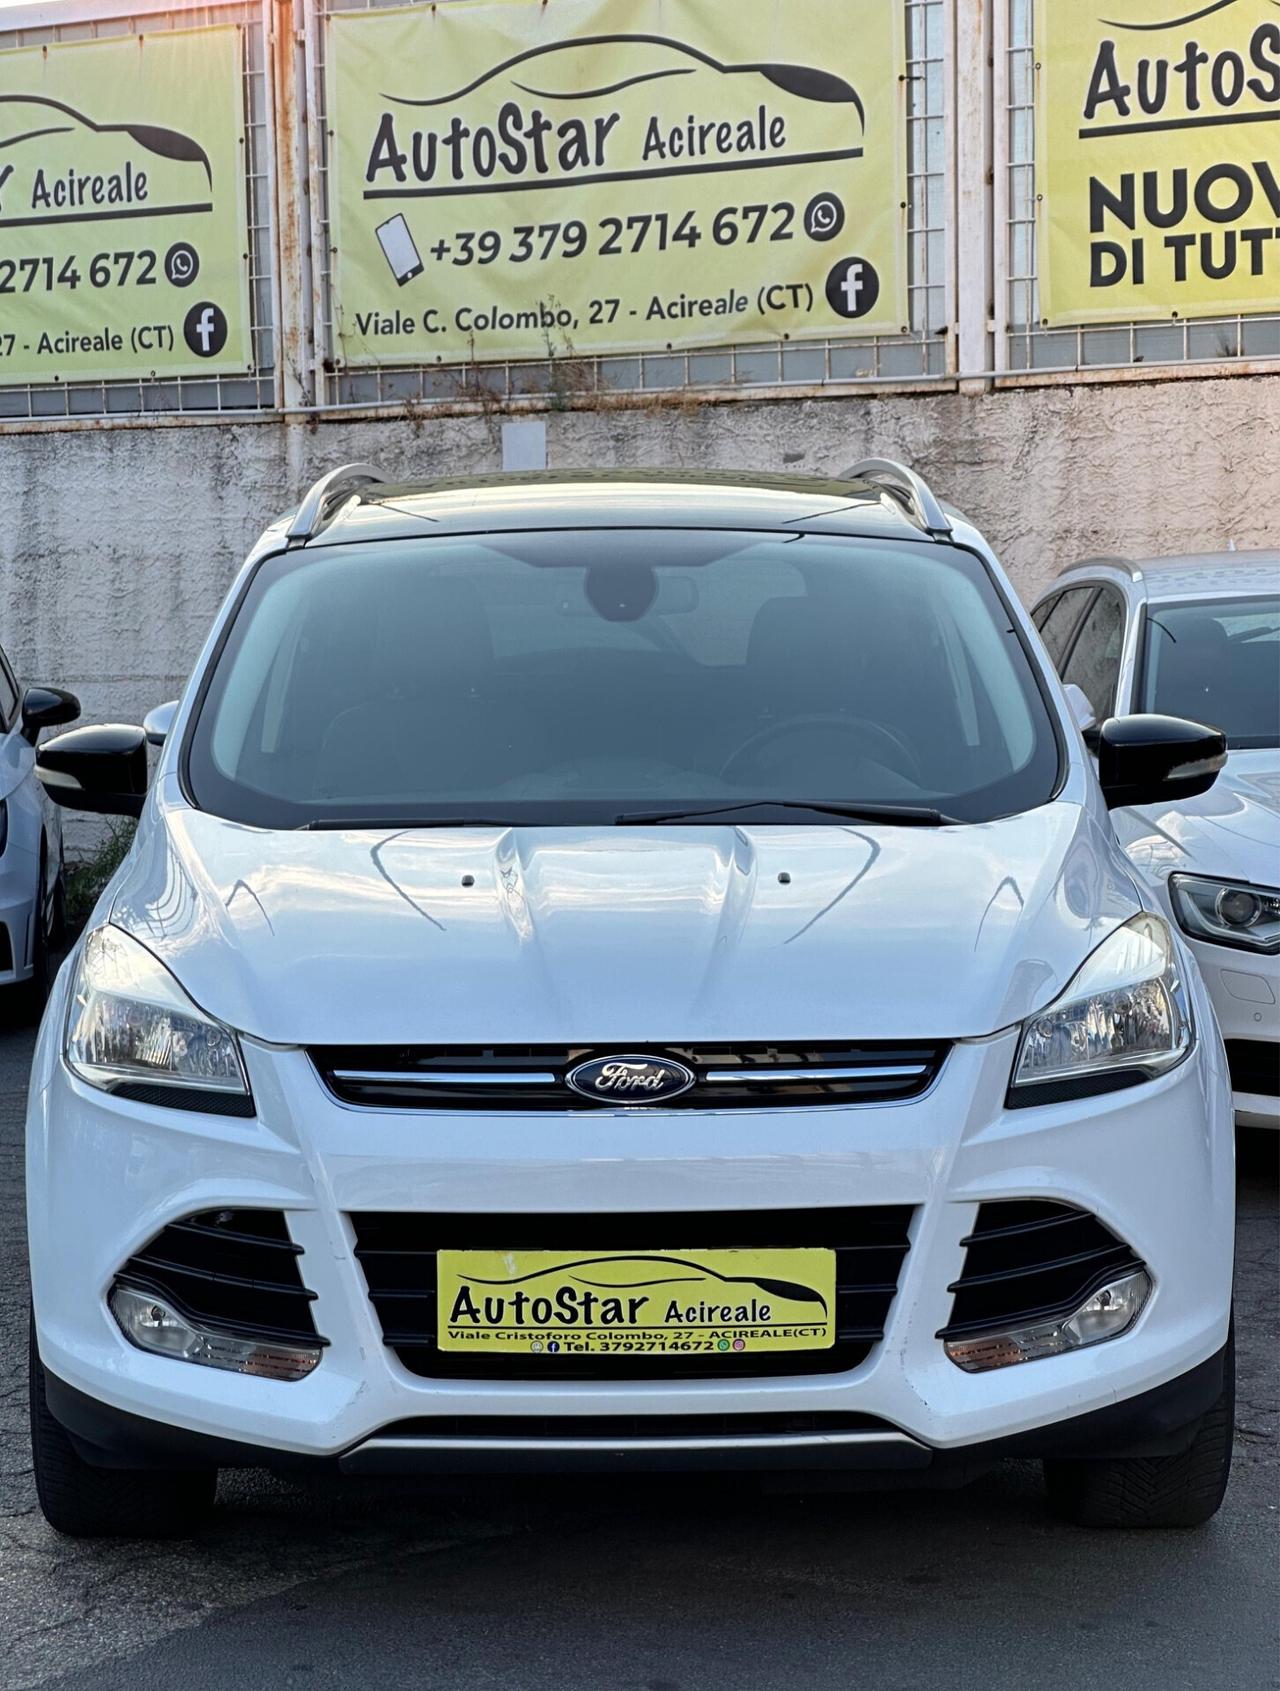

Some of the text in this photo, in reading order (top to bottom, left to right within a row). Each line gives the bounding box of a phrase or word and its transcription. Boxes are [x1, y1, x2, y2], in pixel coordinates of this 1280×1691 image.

[1084, 23, 1280, 120] AutoS
[366, 102, 786, 182] AutoStar Acireale
[32, 162, 148, 209] Acireale
[431, 202, 795, 266] +39 379 2714 672
[0, 250, 157, 293] 2714 672
[1090, 227, 1280, 288] DI TUT
[356, 310, 415, 336] Viale
[423, 309, 447, 333] C.
[455, 301, 579, 332] Colombo,
[589, 298, 620, 325] 27
[646, 288, 749, 320] Acireale
[757, 282, 814, 316] (CT)
[37, 327, 123, 354] Acireale
[131, 326, 174, 353] (CT)
[595, 1062, 665, 1089] Ford
[449, 1285, 772, 1325] AutoStar Acireale
[448, 1331, 491, 1340] Viale
[495, 1331, 582, 1341] Cristoforo
[586, 1331, 668, 1341] Colombo,
[673, 1331, 694, 1340] 27
[708, 1328, 827, 1340] ACIREALE(CT)
[563, 1340, 714, 1352] Tel. 3792714672
